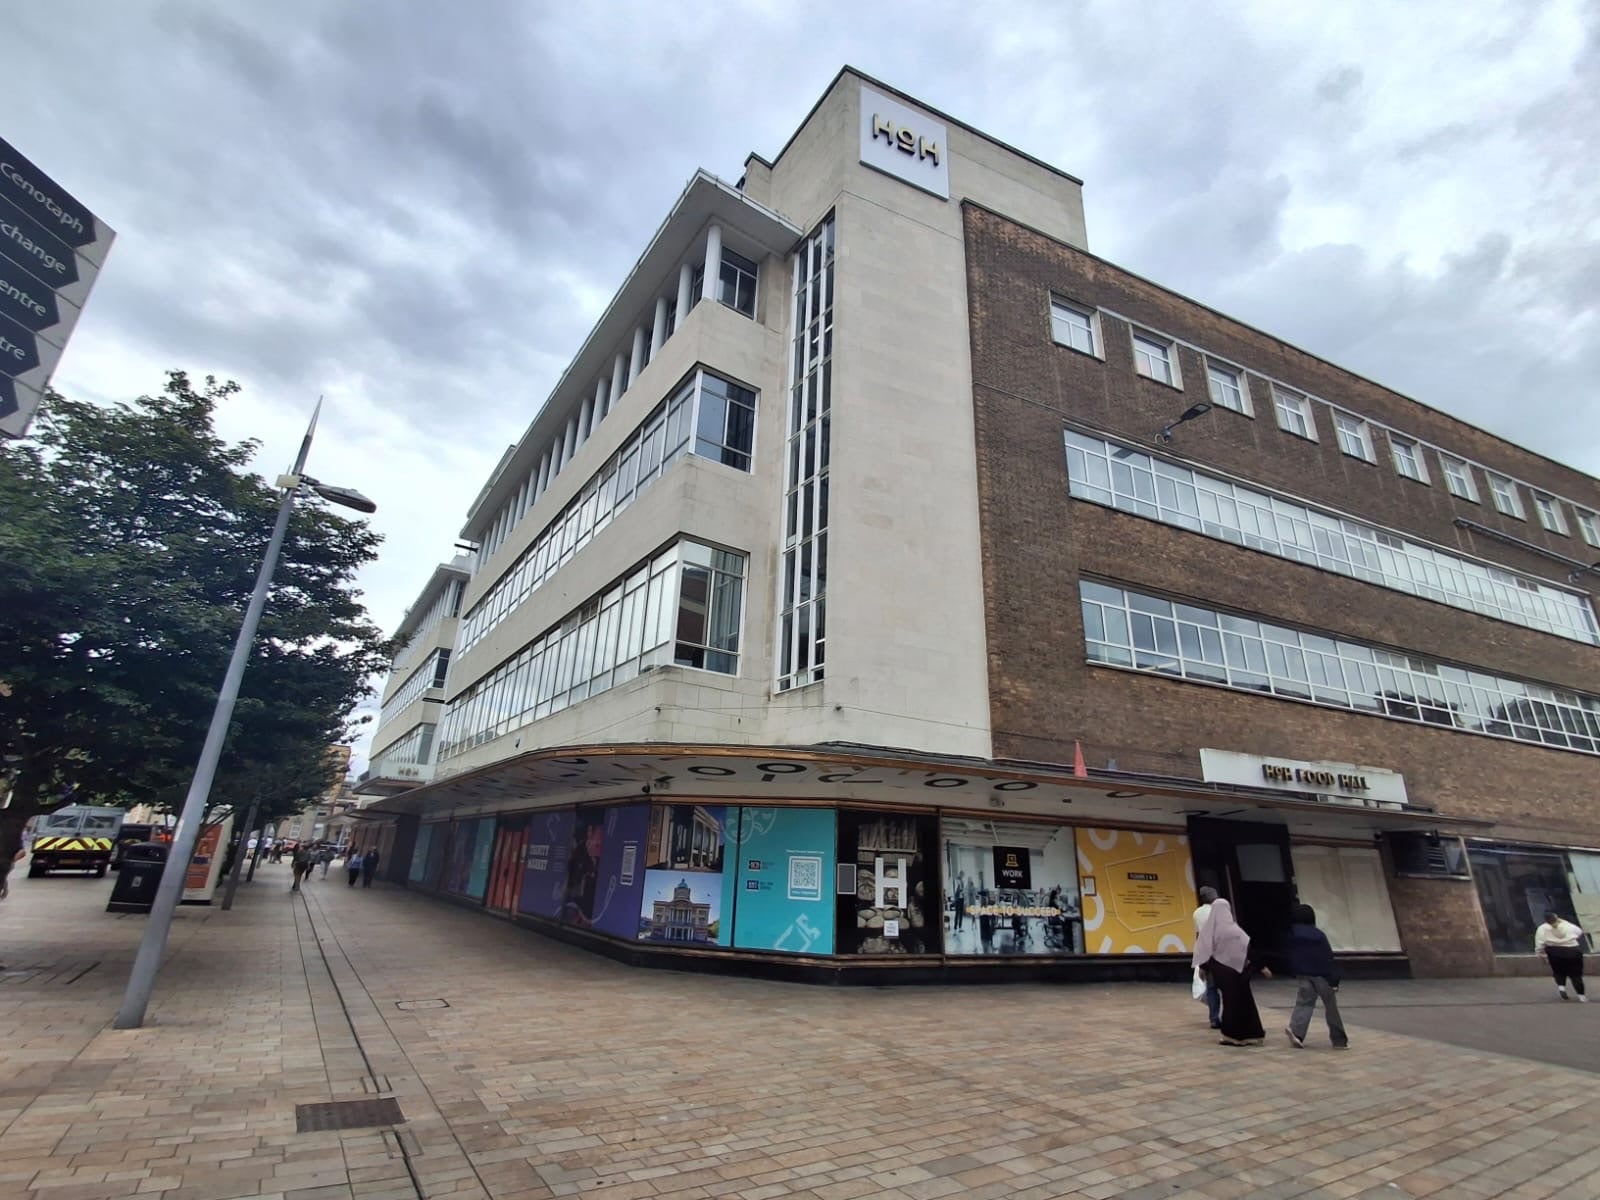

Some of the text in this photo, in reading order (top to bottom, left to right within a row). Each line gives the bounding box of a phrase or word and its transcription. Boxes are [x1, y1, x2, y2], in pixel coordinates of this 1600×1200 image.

[0, 162, 84, 234] Cenotaph
[0, 219, 67, 274] change
[1295, 768, 1336, 786] FOOD
[1001, 869, 1024, 879] WORK
[969, 904, 999, 917] SPACE
[1016, 905, 1058, 918] SUCCEED
